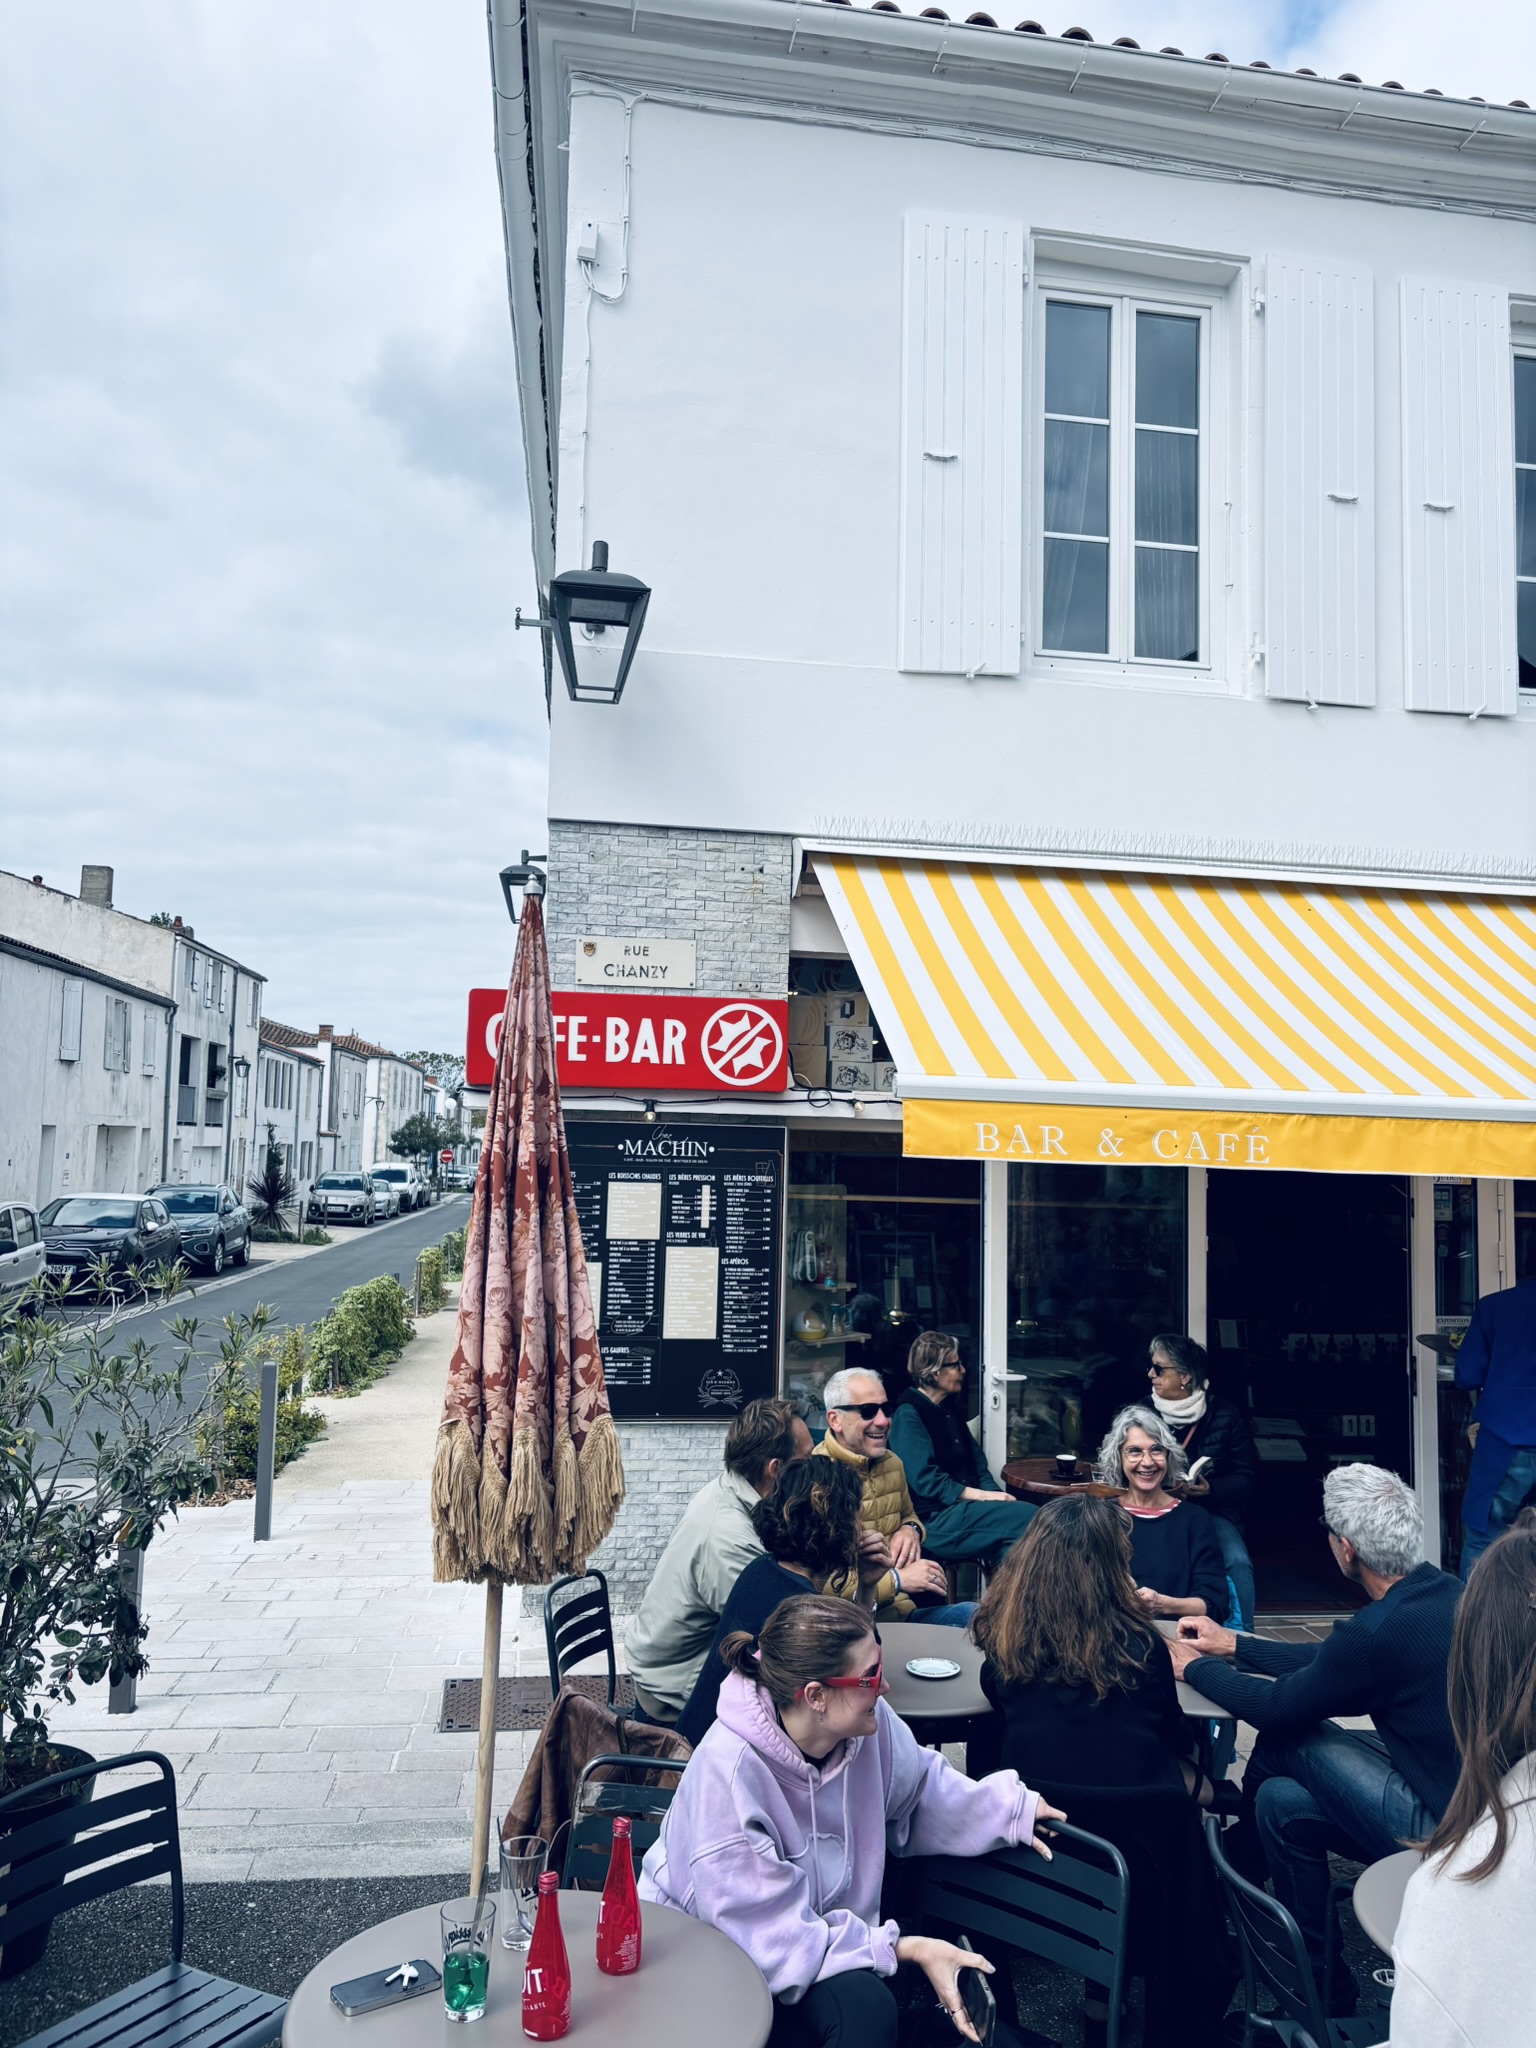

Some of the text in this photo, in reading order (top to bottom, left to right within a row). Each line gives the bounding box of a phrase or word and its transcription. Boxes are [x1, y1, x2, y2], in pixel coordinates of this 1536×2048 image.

[624, 945, 650, 957] RUE
[603, 963, 668, 979] CHANZY
[623, 1139, 709, 1158] MACHIN
[973, 1122, 1271, 1165] BAR & CAFÉ
[729, 1257, 749, 1265] APÉROS
